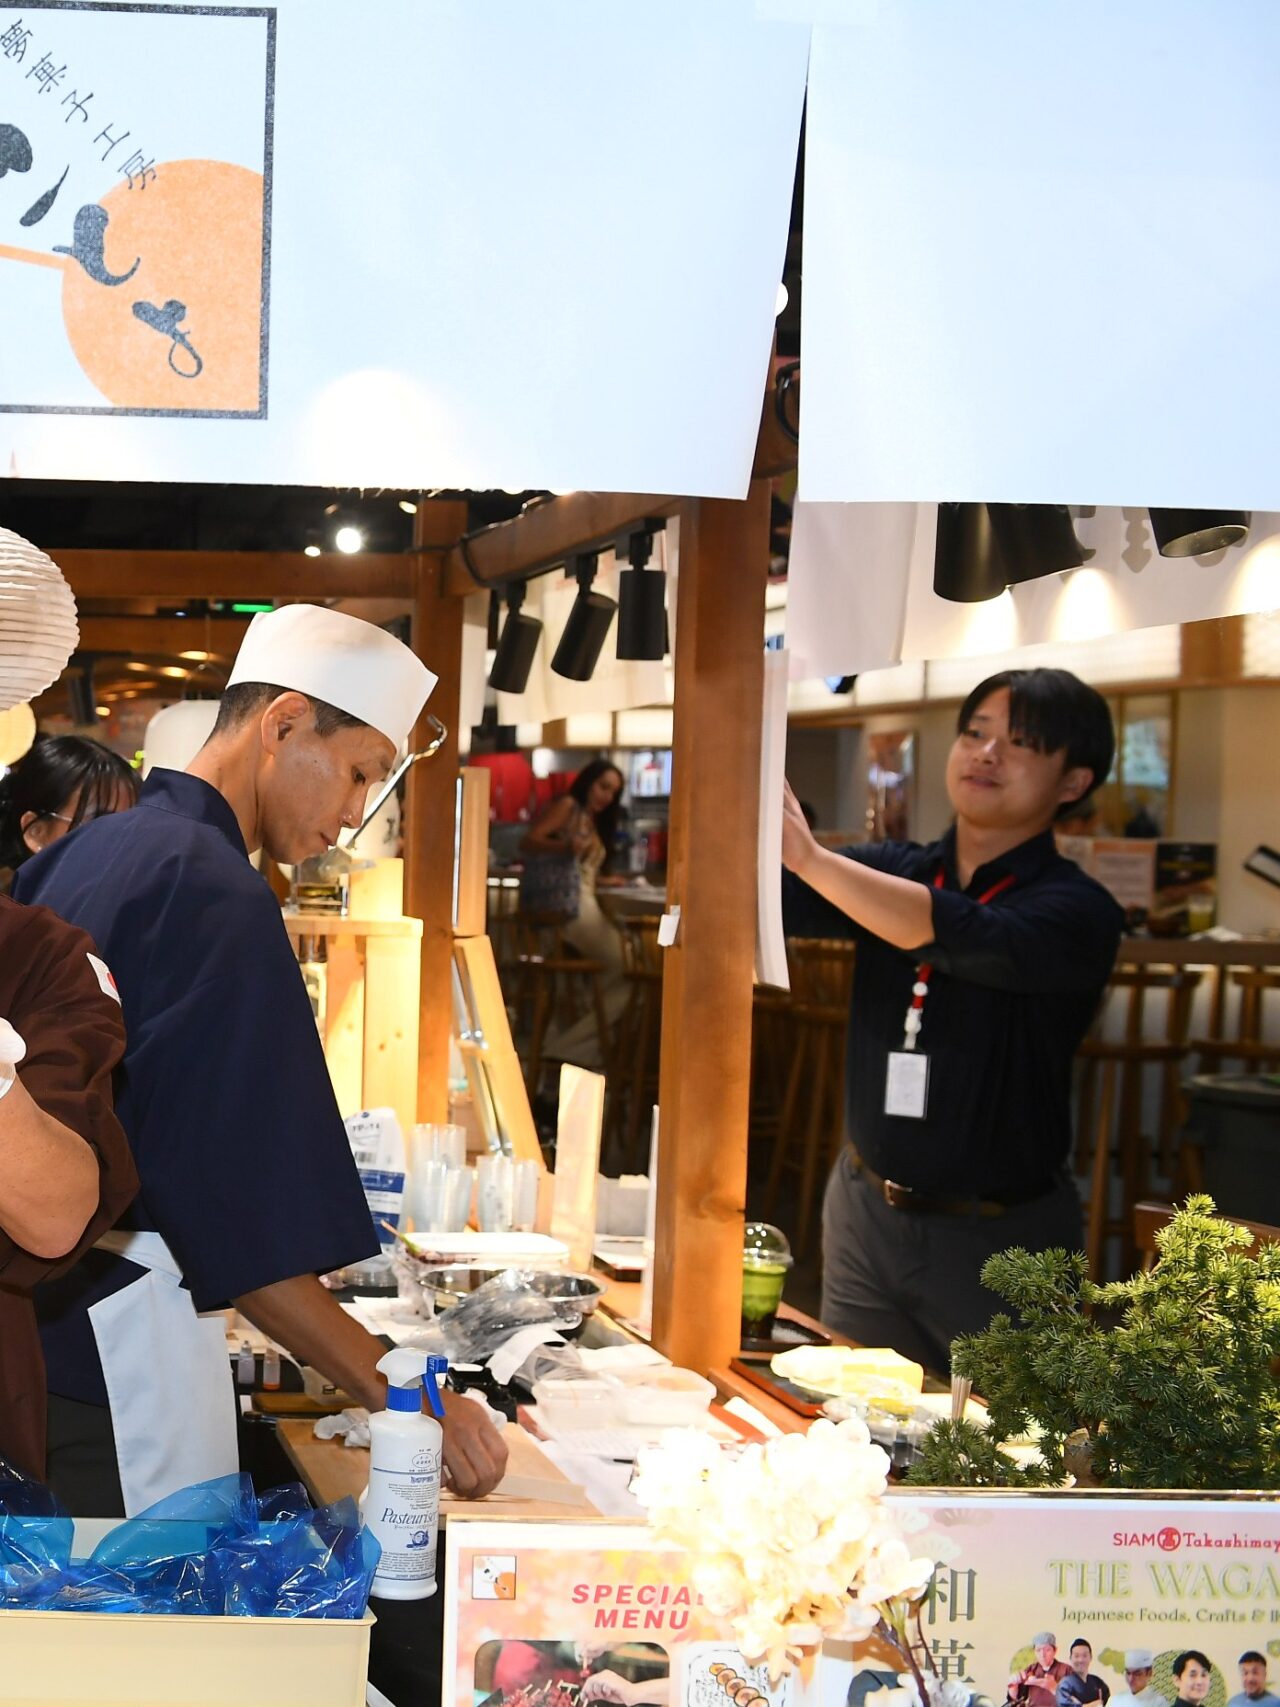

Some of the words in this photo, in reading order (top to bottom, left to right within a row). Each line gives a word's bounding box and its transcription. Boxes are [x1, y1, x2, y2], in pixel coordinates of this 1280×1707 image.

[1113, 1532, 1155, 1547] SIAM
[1048, 1560, 1133, 1599] THE
[1148, 1559, 1280, 1600] WAGA
[594, 1609, 690, 1630] MENU
[1062, 1607, 1134, 1625] Japanese
[1139, 1608, 1190, 1623] Foods,
[1196, 1608, 1247, 1623] Crafts
